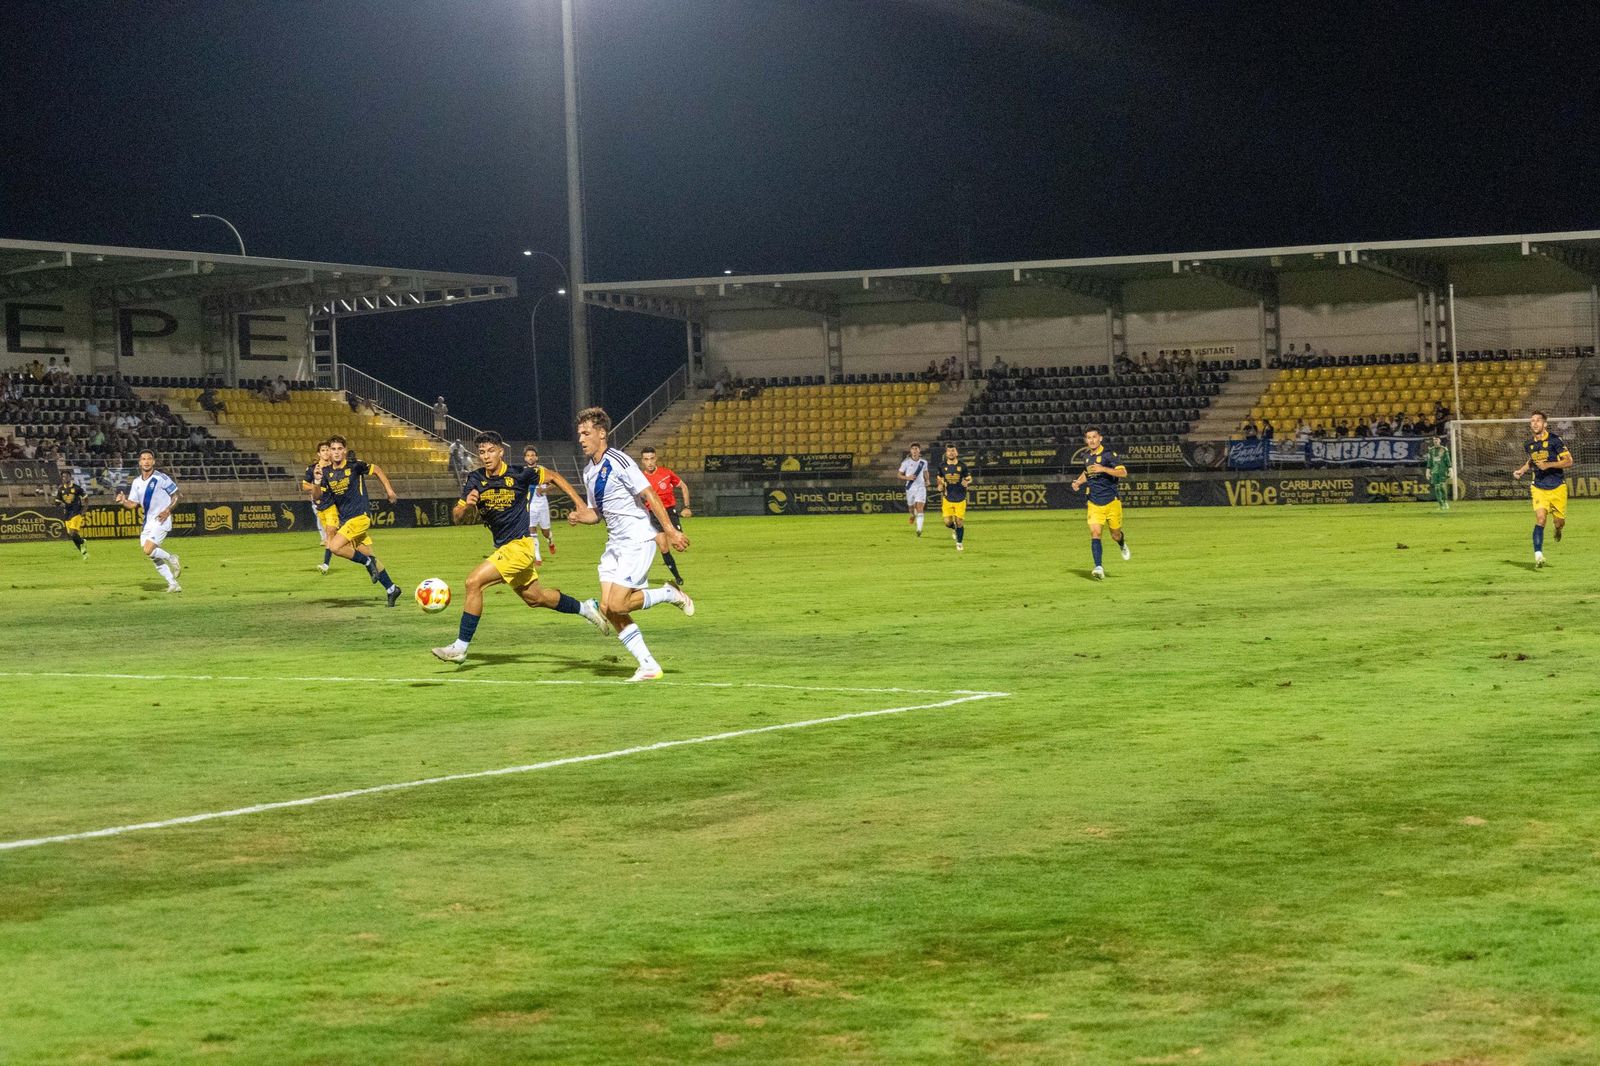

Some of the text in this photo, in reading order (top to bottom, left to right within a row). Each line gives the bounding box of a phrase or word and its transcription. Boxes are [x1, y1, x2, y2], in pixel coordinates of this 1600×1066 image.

[1128, 444, 1182, 453] PANADERÍA
[1155, 482, 1180, 490] LEPE
[1280, 480, 1354, 490] CARBURANTES
[828, 492, 853, 502] Orta
[966, 490, 1048, 505] LEPEBOX
[117, 507, 137, 526] del
[0, 523, 46, 534] CRISAUTO
